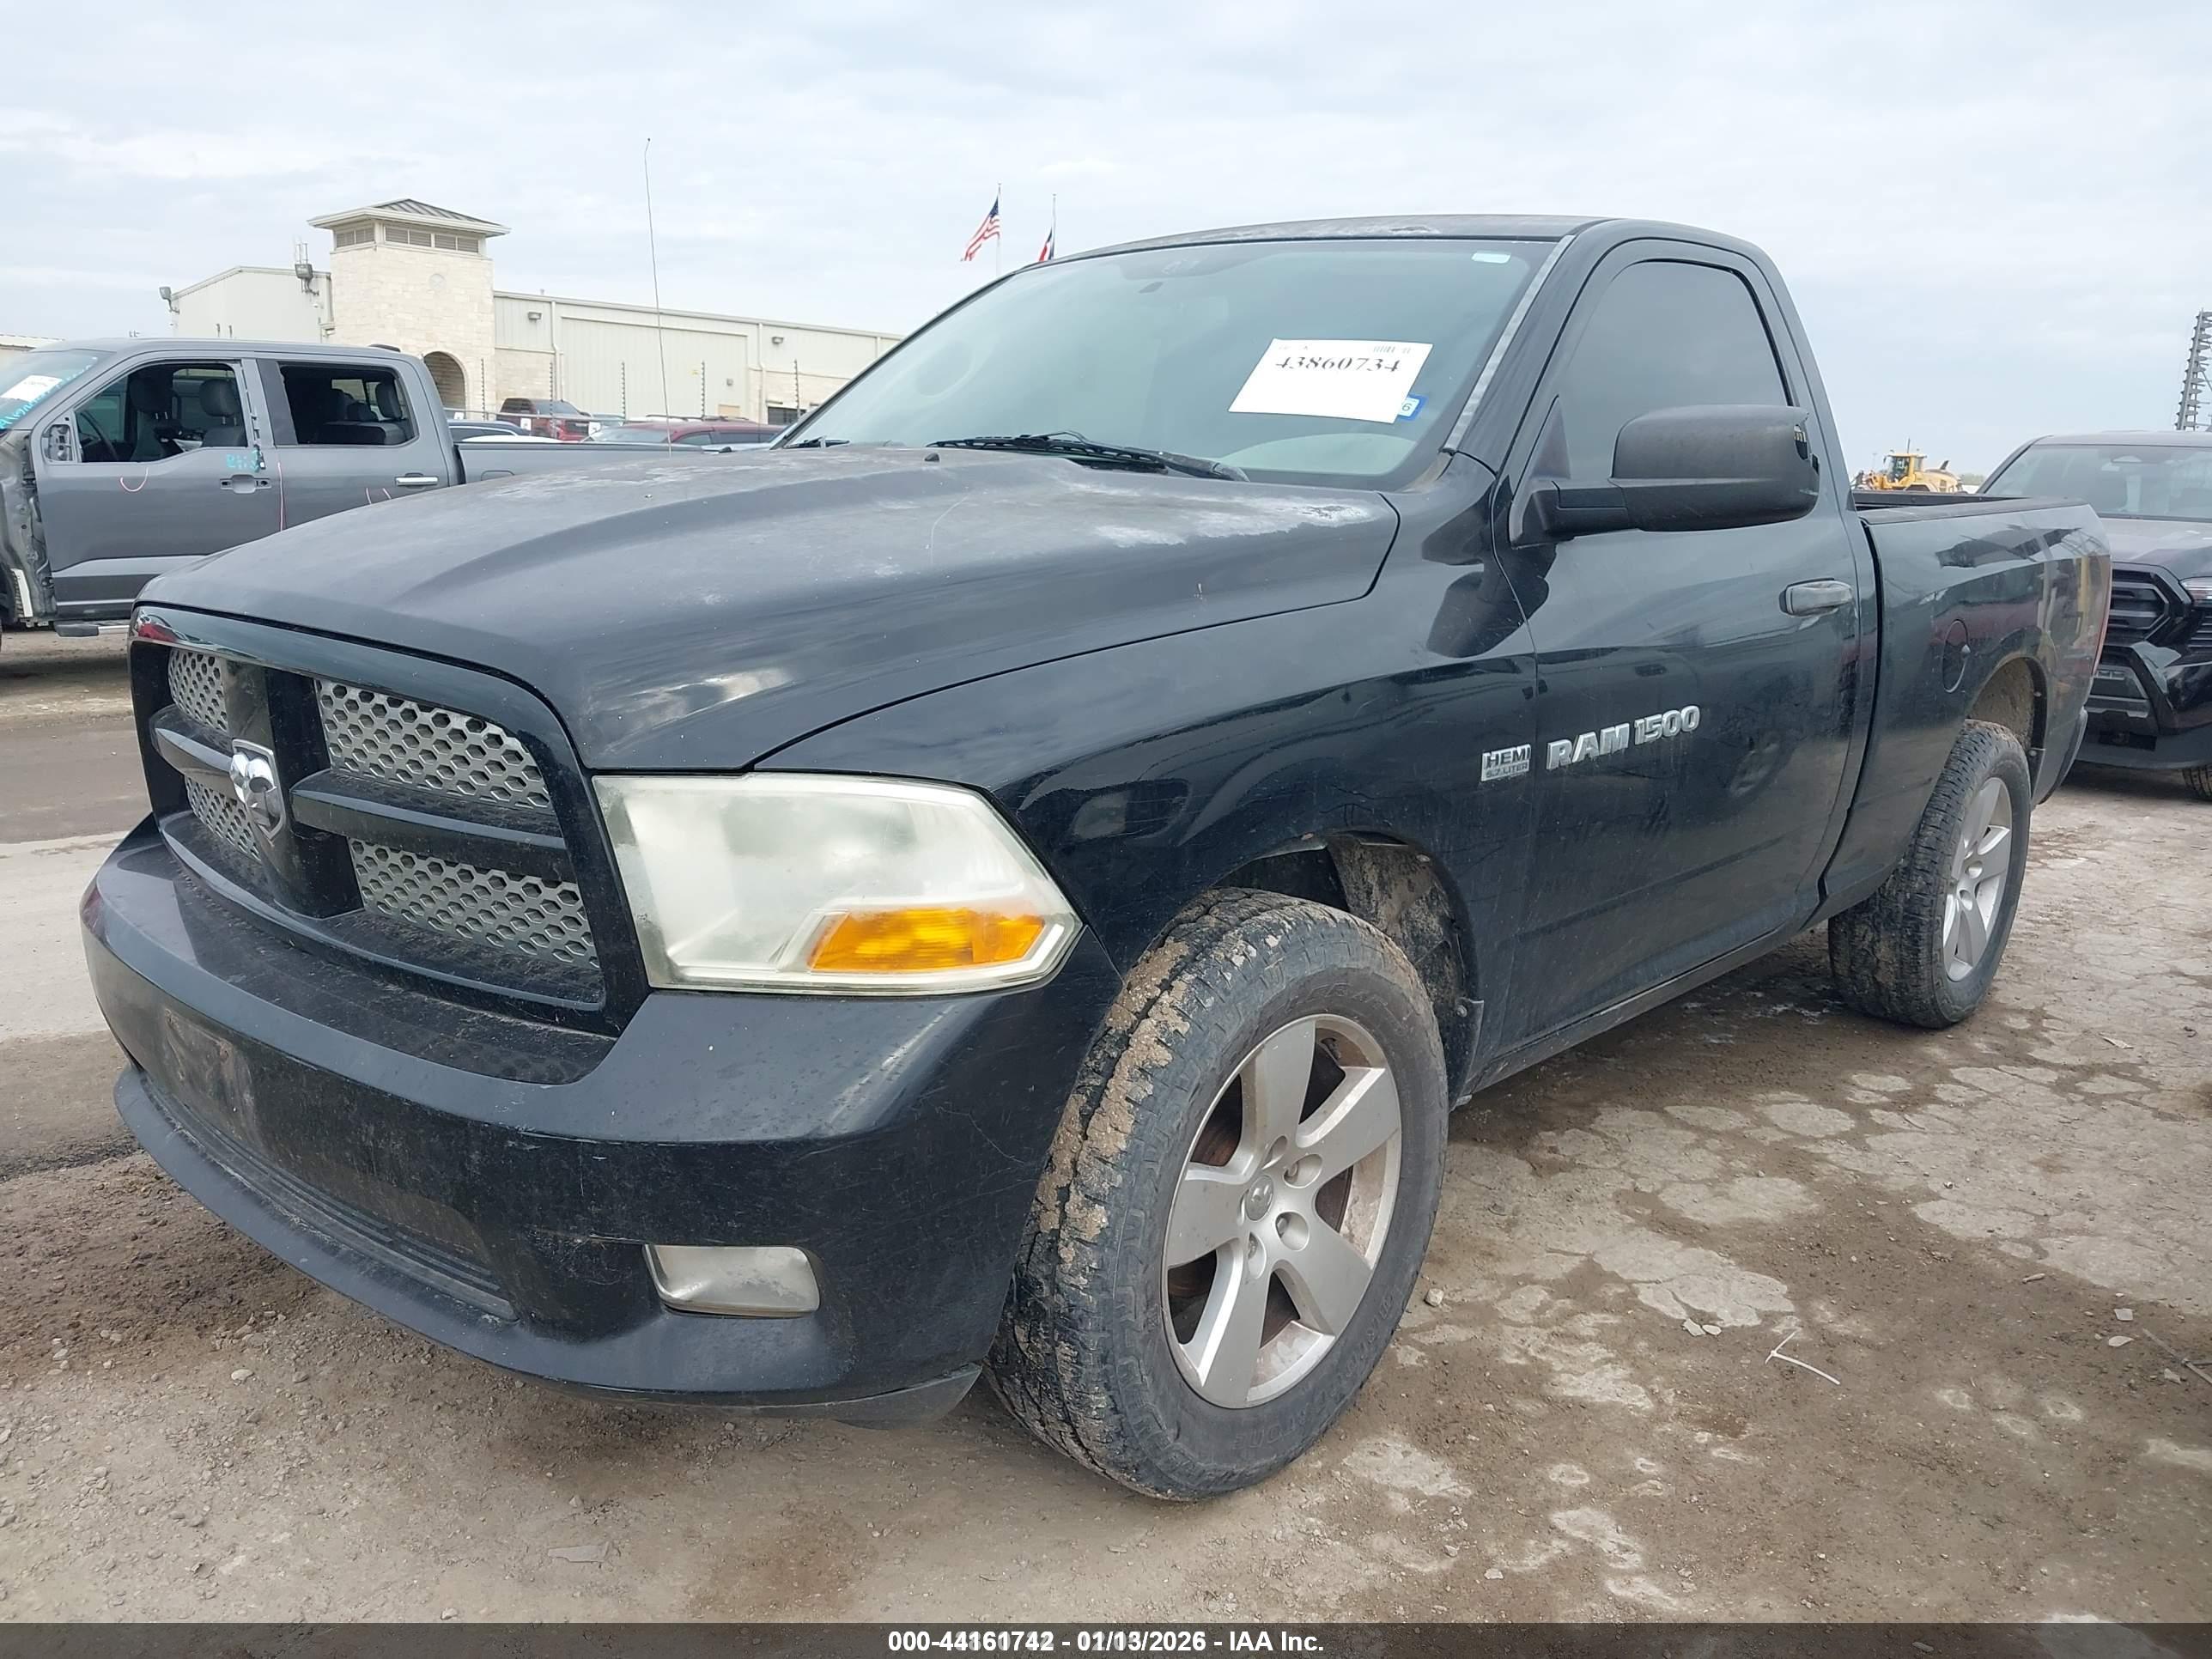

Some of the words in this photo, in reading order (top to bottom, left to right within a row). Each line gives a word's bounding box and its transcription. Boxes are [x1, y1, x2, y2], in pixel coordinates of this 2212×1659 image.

[1275, 356, 1401, 372] 43860734
[1547, 723, 1630, 769] RAM
[1633, 705, 1700, 745] 1500
[1482, 744, 1531, 769] HEMI
